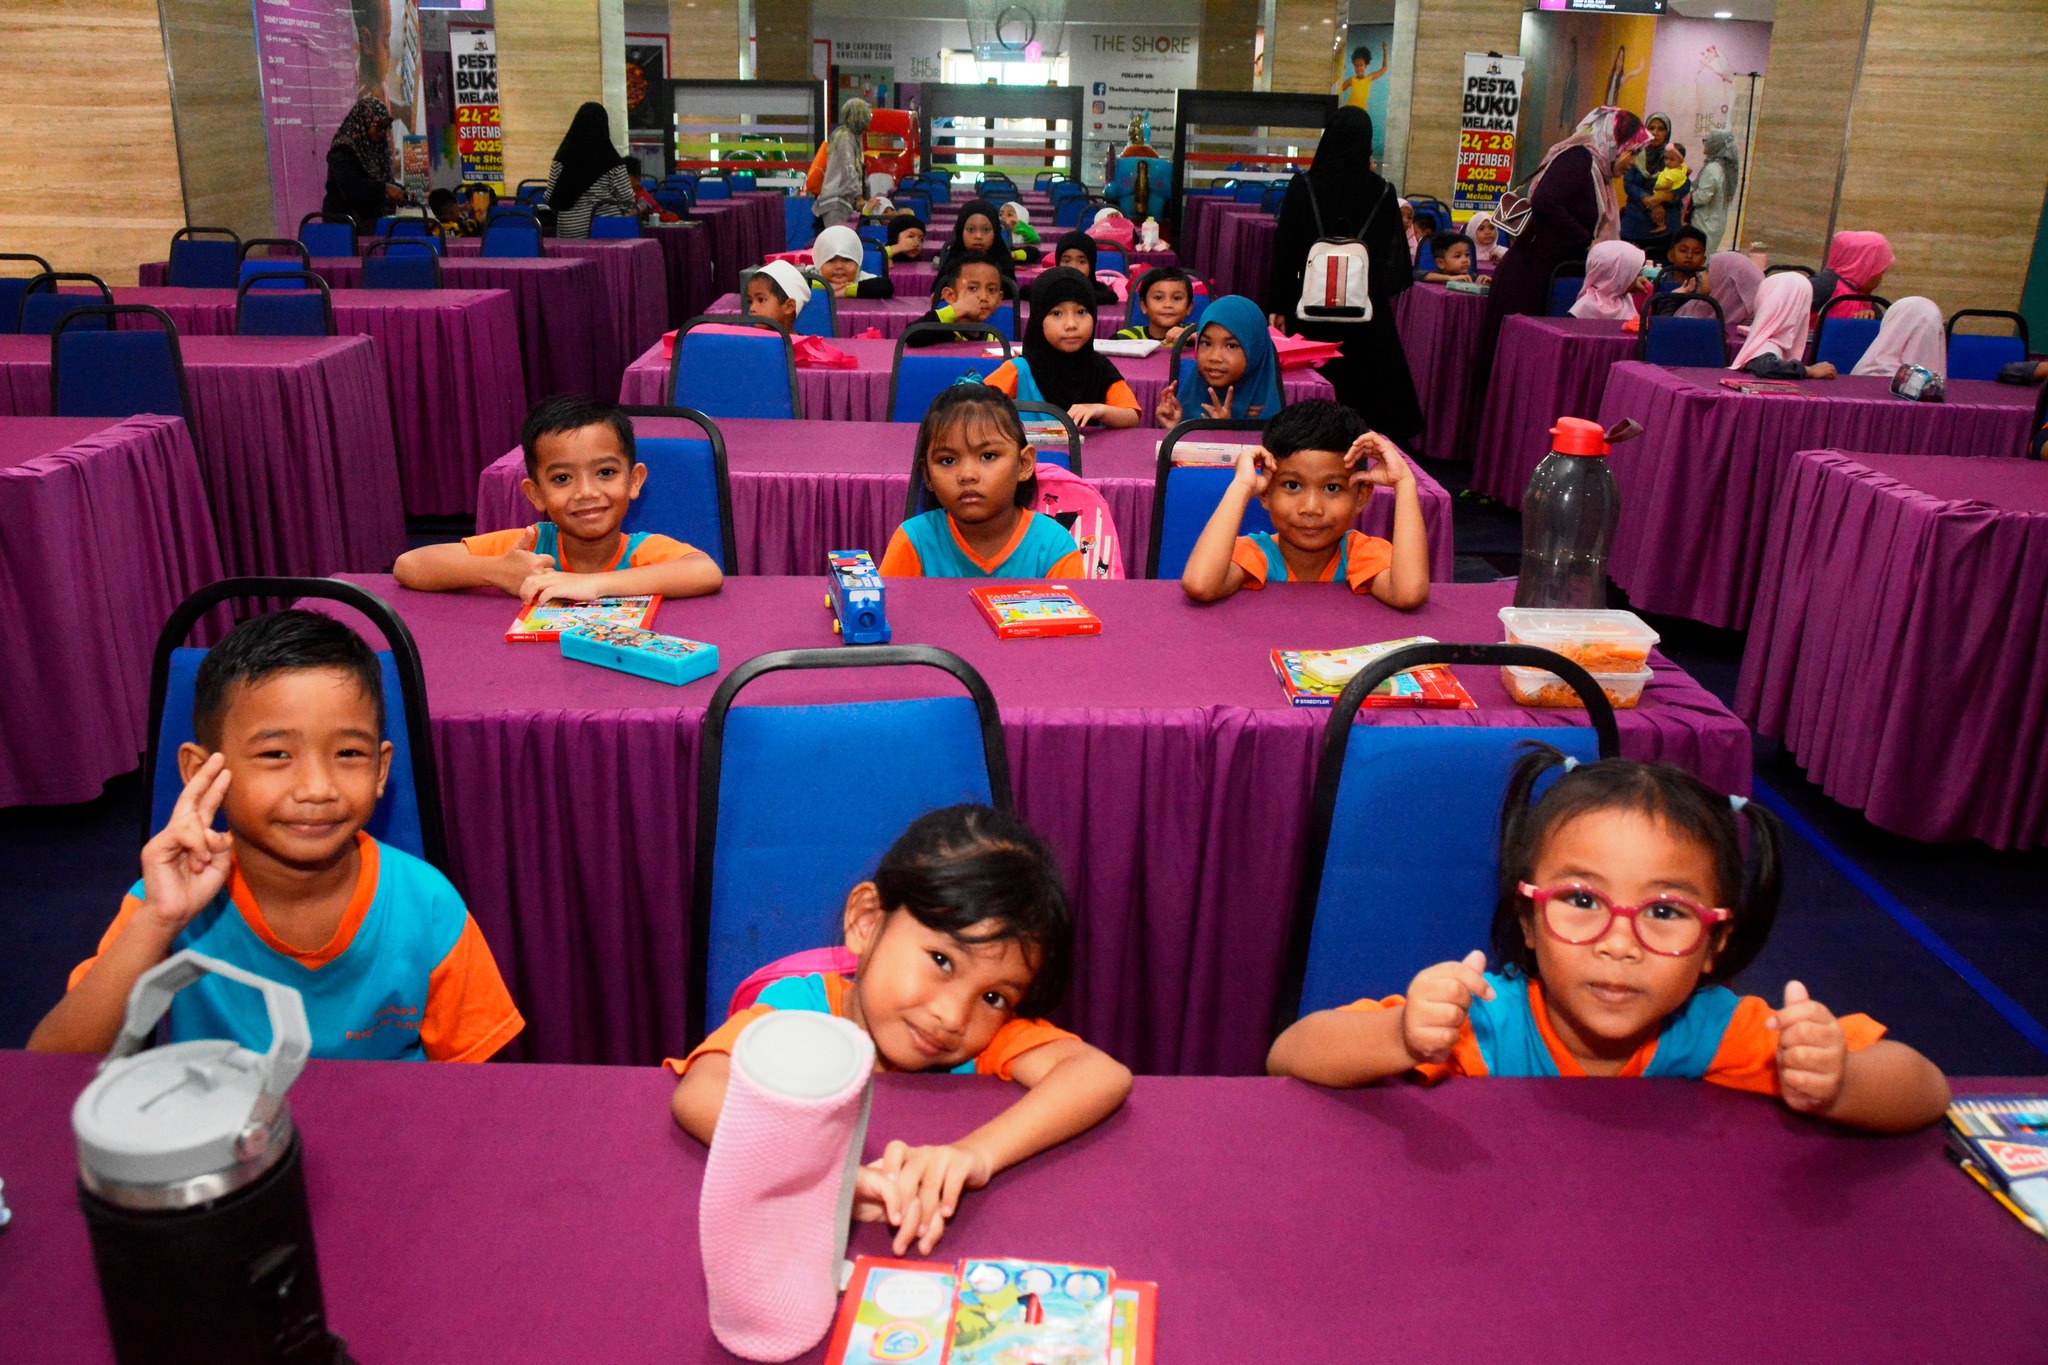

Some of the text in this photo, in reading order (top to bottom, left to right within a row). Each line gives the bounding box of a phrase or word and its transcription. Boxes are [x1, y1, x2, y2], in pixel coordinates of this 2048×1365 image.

[836, 42, 892, 52] NEW EXPERIENCE
[1092, 34, 1191, 54] THE SHORE
[457, 53, 497, 69] PEST
[836, 51, 892, 60] UNVEILING SOON
[910, 57, 931, 67] THE
[910, 68, 941, 78] SHOR
[456, 70, 498, 90] BUK
[1467, 76, 1517, 95] PESTA
[1109, 86, 1175, 95] TheShoreShoppingGaller
[458, 92, 498, 104] MELAK
[1463, 94, 1519, 117] BUKU
[459, 108, 500, 124] 24-2
[1695, 113, 1714, 122] THE
[1462, 117, 1514, 132] MELAKA
[460, 126, 501, 139] SEPTEMB
[473, 140, 502, 152] 2025
[1461, 133, 1514, 151] 24-28
[462, 154, 503, 163] The Sho
[1459, 152, 1511, 168] SEPTEMBER
[1467, 167, 1497, 180] 2025
[1456, 182, 1507, 193] The Shore
[1466, 193, 1493, 201] Melaka
[1299, 697, 1330, 705] STAEDTLER
